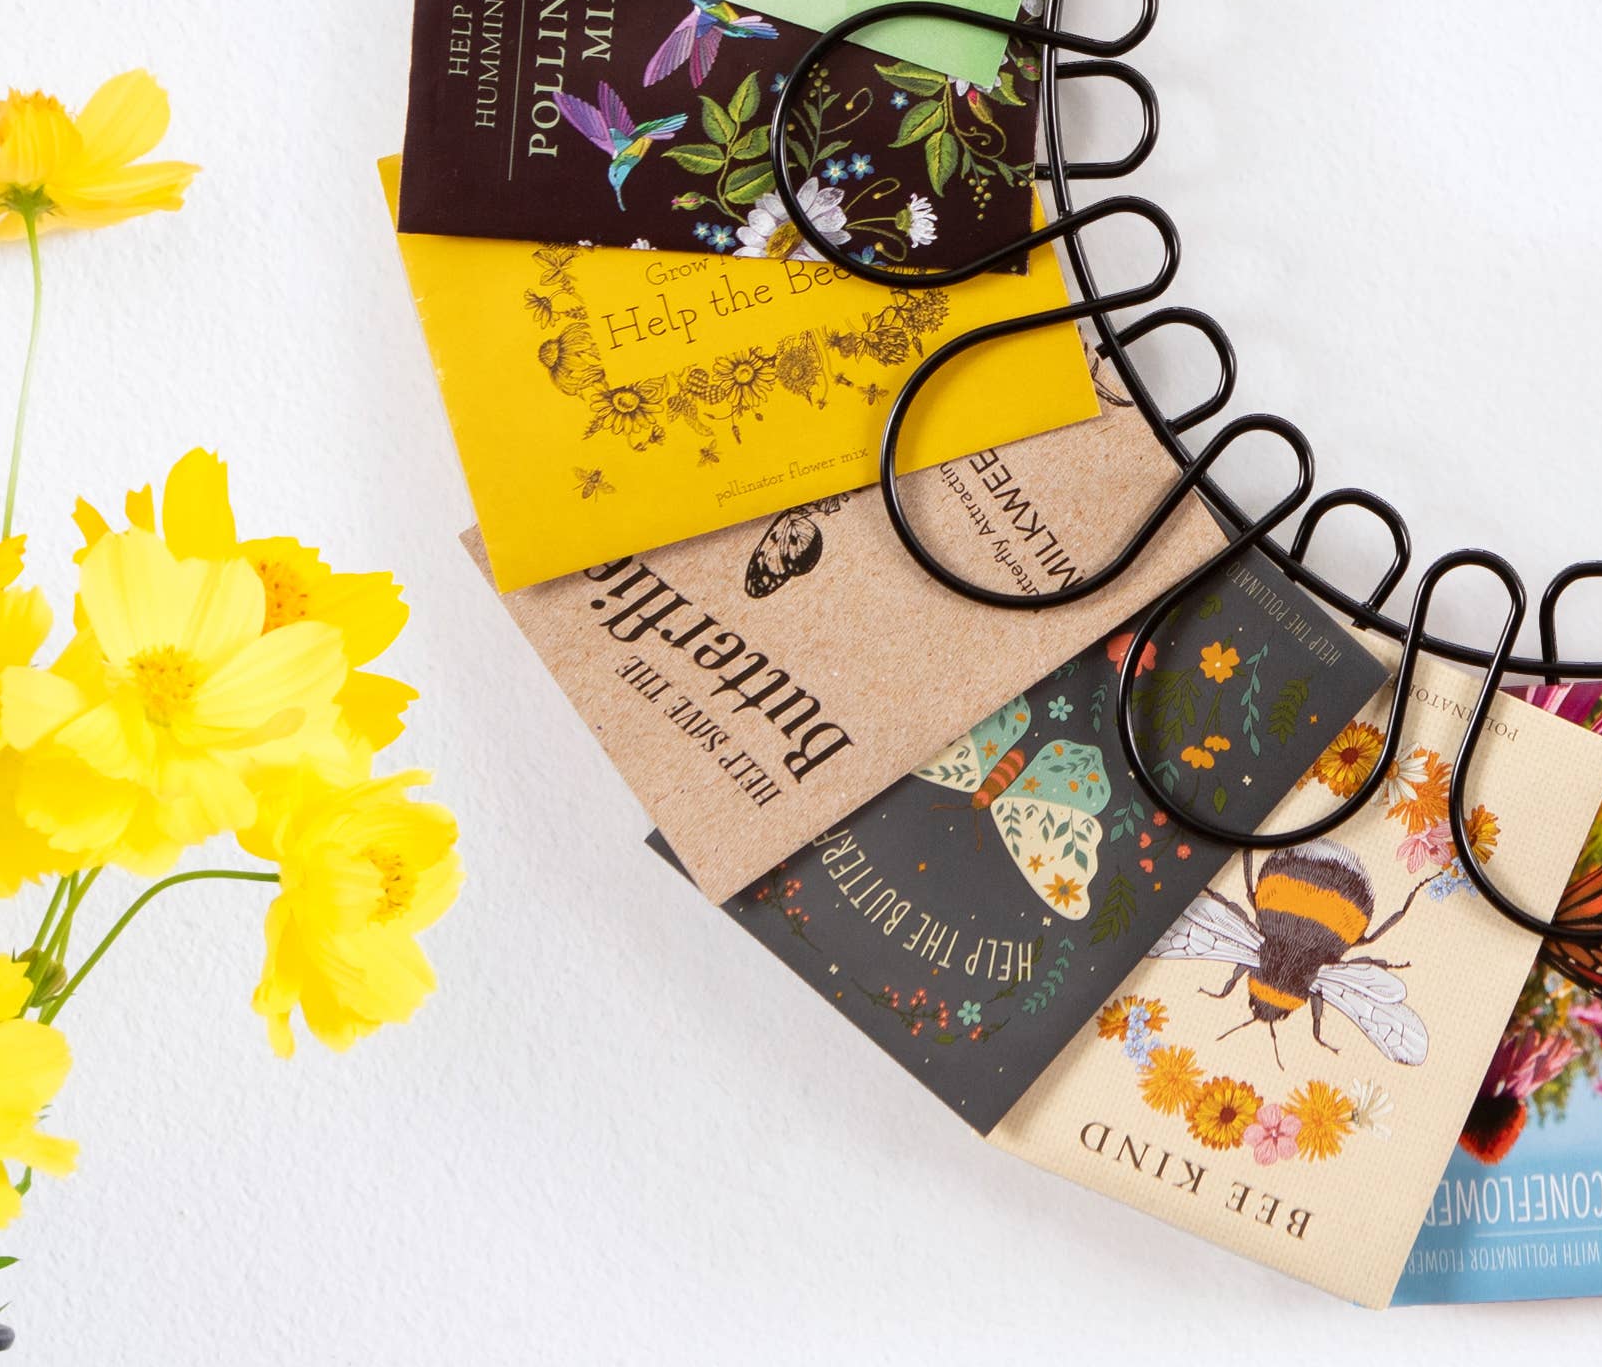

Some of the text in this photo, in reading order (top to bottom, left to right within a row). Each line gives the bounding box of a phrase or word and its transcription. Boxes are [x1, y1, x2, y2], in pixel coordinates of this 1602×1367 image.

[448, 5, 473, 76] HELP
[645, 257, 709, 286] Grow
[601, 294, 697, 350] Help
[709, 274, 774, 317] the
[715, 447, 869, 507] pollinator flower mix
[992, 539, 1040, 596] utterfly
[1284, 614, 1312, 643] THE
[1309, 636, 1342, 667] HELP
[615, 655, 782, 808] HELP SAVE THE
[902, 912, 960, 969] THE
[965, 936, 1032, 982] HELP
[1079, 1121, 1314, 1241] BEE KIND
[1470, 1243, 1558, 1272] POLLINATOR
[1564, 1240, 1599, 1266] WITH
